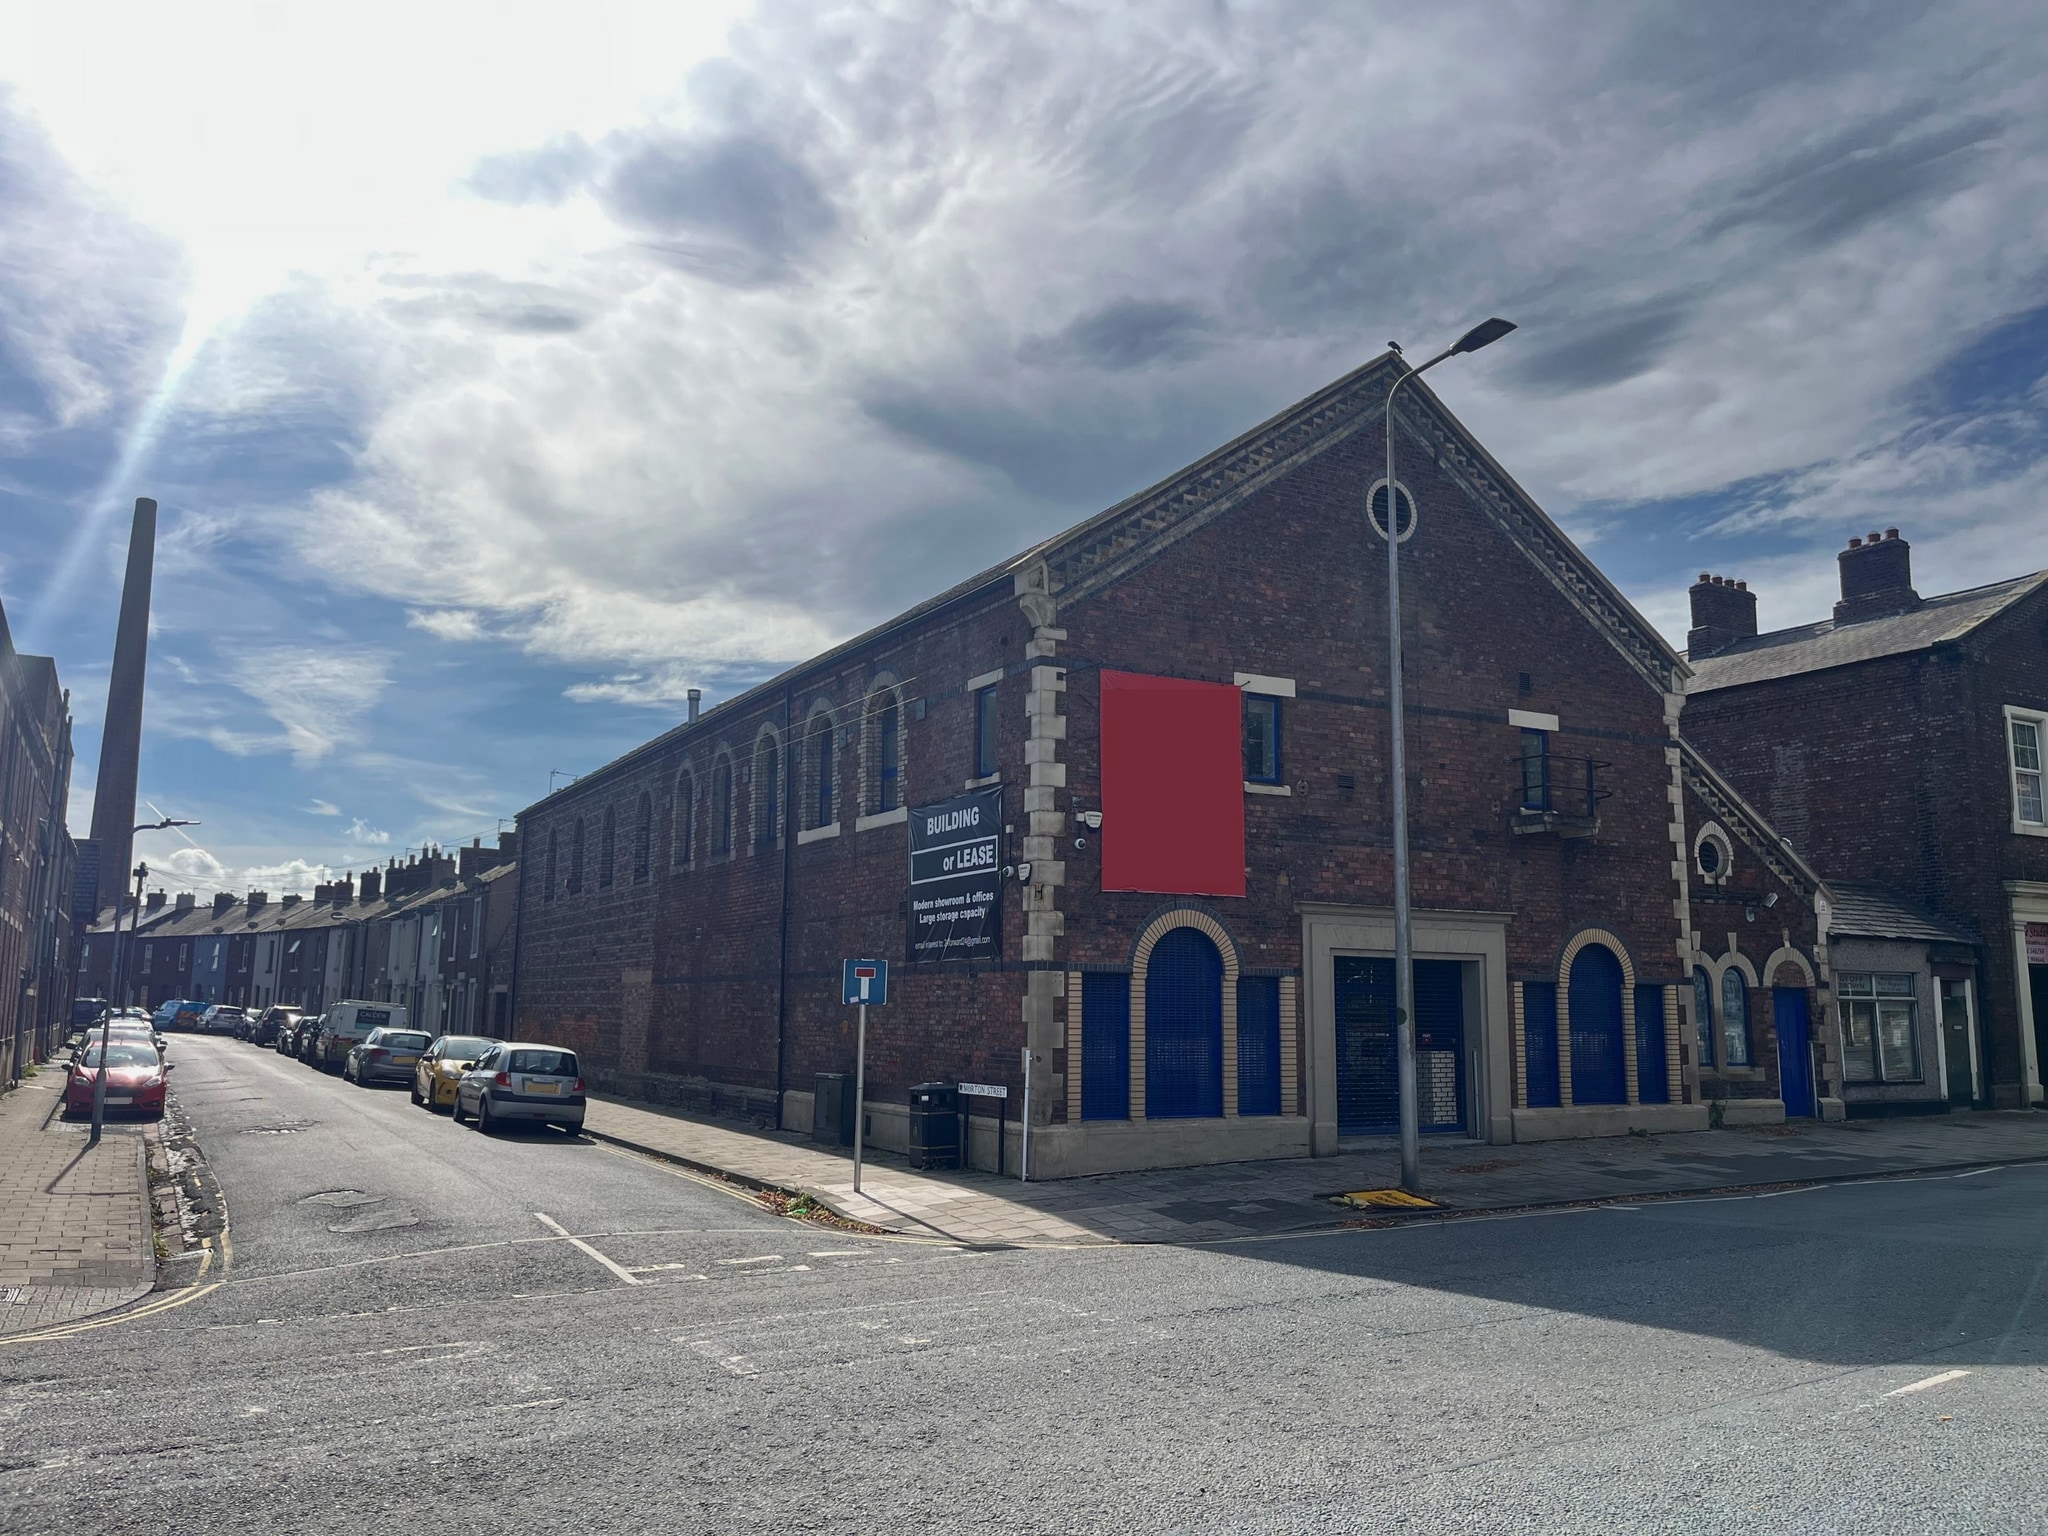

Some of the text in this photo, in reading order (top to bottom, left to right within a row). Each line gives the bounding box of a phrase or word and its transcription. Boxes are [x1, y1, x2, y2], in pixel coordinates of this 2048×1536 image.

[927, 806, 979, 835] BUILDING
[957, 845, 994, 868] LEASE
[913, 891, 994, 910] Modern showroom & offices
[920, 906, 985, 925] Large storage capacity
[987, 1086, 1006, 1096] STREET
